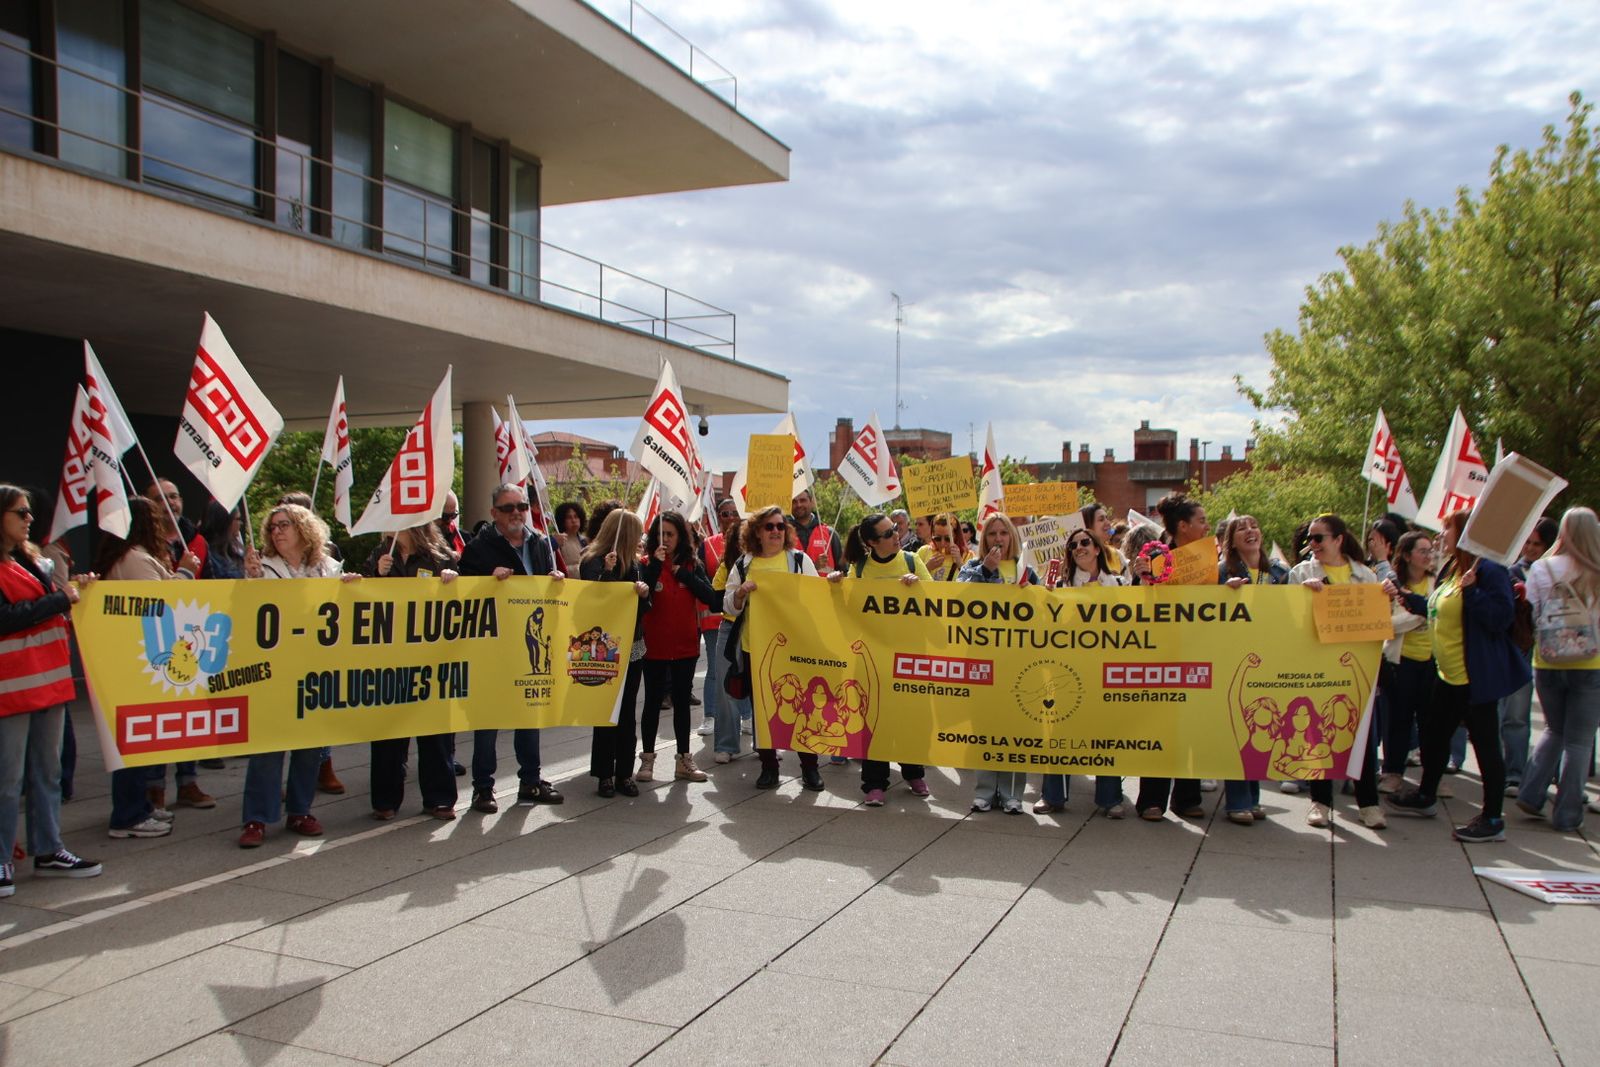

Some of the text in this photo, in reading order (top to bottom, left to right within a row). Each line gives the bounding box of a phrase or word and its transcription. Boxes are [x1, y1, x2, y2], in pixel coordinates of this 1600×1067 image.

[909, 466, 920, 476] NO
[103, 595, 165, 617] MALTRATO
[862, 596, 1252, 623] ABANDONO Y VIOLENCIA
[352, 601, 394, 645] EN
[406, 597, 498, 643] LUCHA
[947, 625, 1157, 649] INSTITUCIONAL
[790, 655, 848, 668] MENOS RATIOS
[896, 657, 965, 679] CCOO
[208, 661, 272, 693] SOLUCIONES
[1106, 666, 1182, 683] CCOO
[1306, 680, 1351, 688] LABORALES
[297, 661, 468, 719] ¡SOLUCIONES YA!
[525, 687, 551, 698] EN PIE
[893, 682, 970, 697] enseñanza
[1103, 690, 1186, 702] enseñanza
[126, 708, 239, 743] CCOO
[937, 732, 1163, 751] SOMOS LA VOZ DE LA INFANCIA
[983, 751, 1115, 767] 0-3 ES EDUCACIÓN
